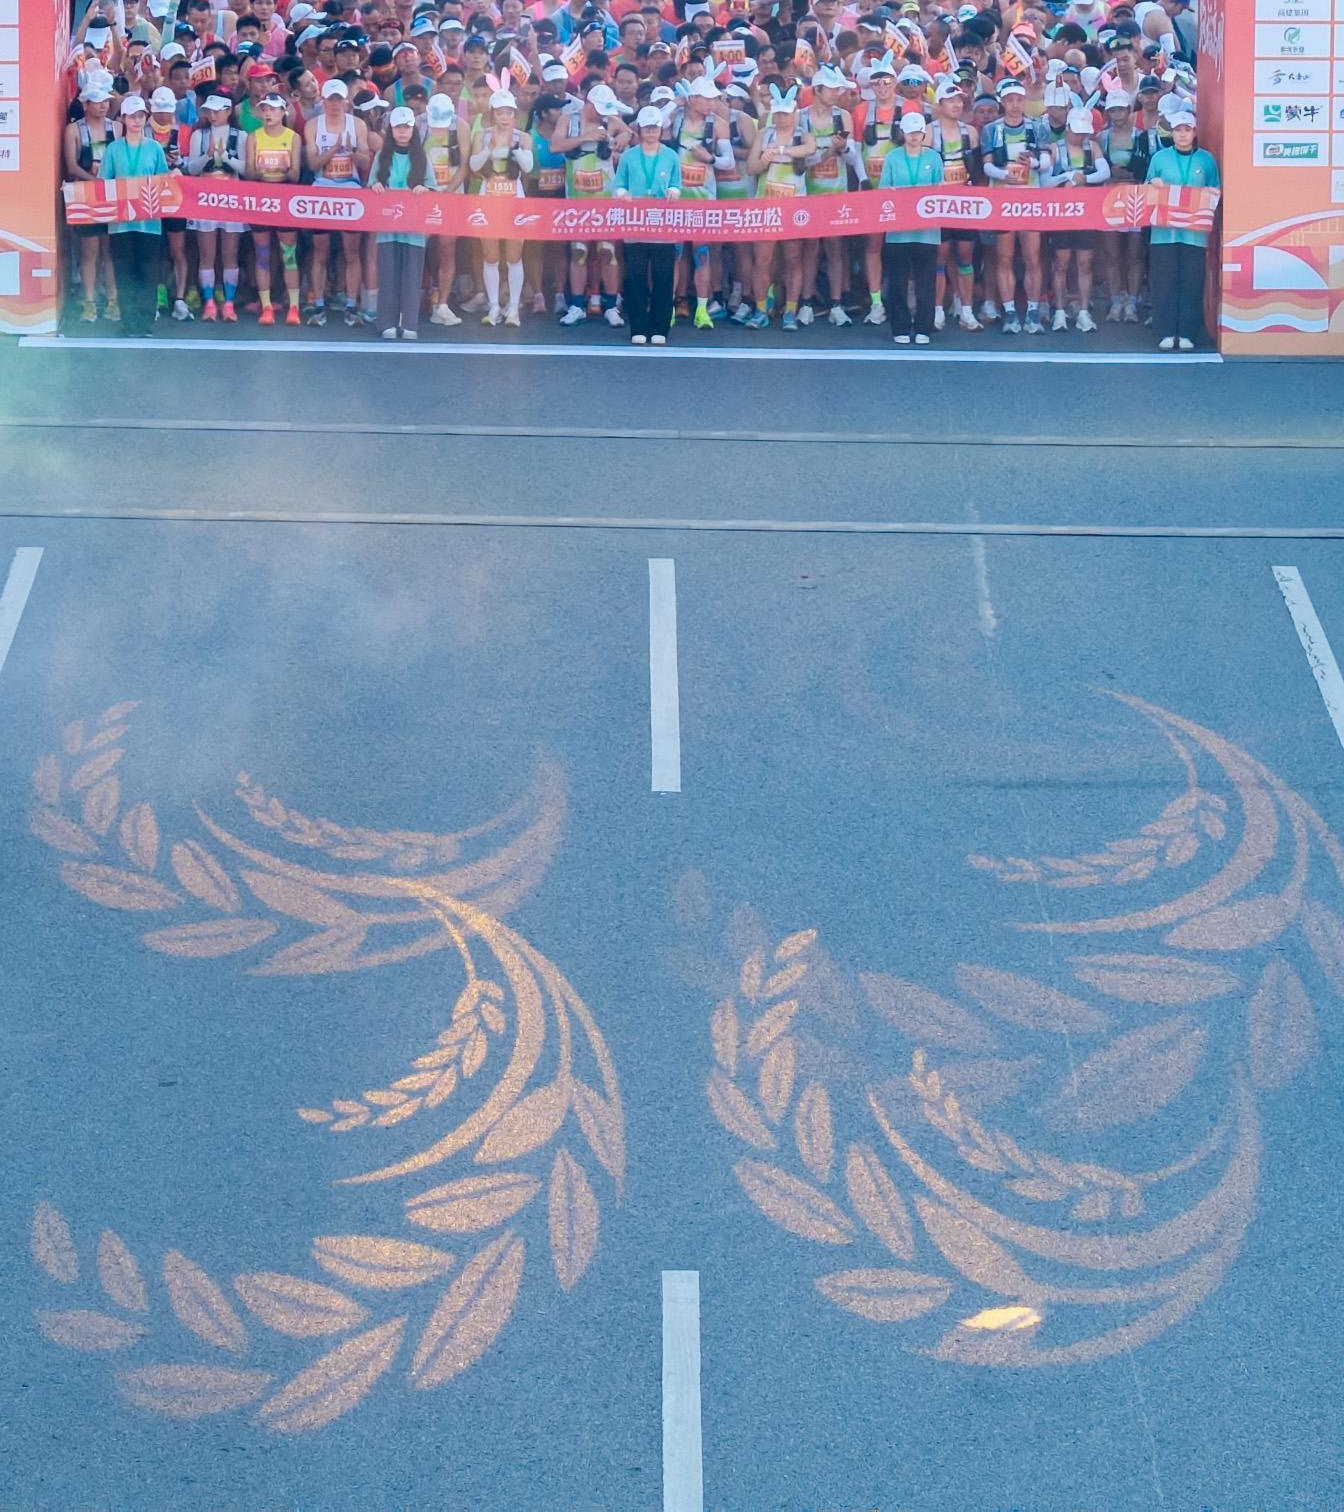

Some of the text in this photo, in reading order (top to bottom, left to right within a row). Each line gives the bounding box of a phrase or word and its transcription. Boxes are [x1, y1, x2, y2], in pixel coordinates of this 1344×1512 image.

[1285, 104, 1320, 123] 蒙牛
[197, 192, 281, 213] 2025.11.23
[296, 199, 357, 218] START
[923, 199, 986, 218] START
[1001, 200, 1086, 218] 2025.11.23
